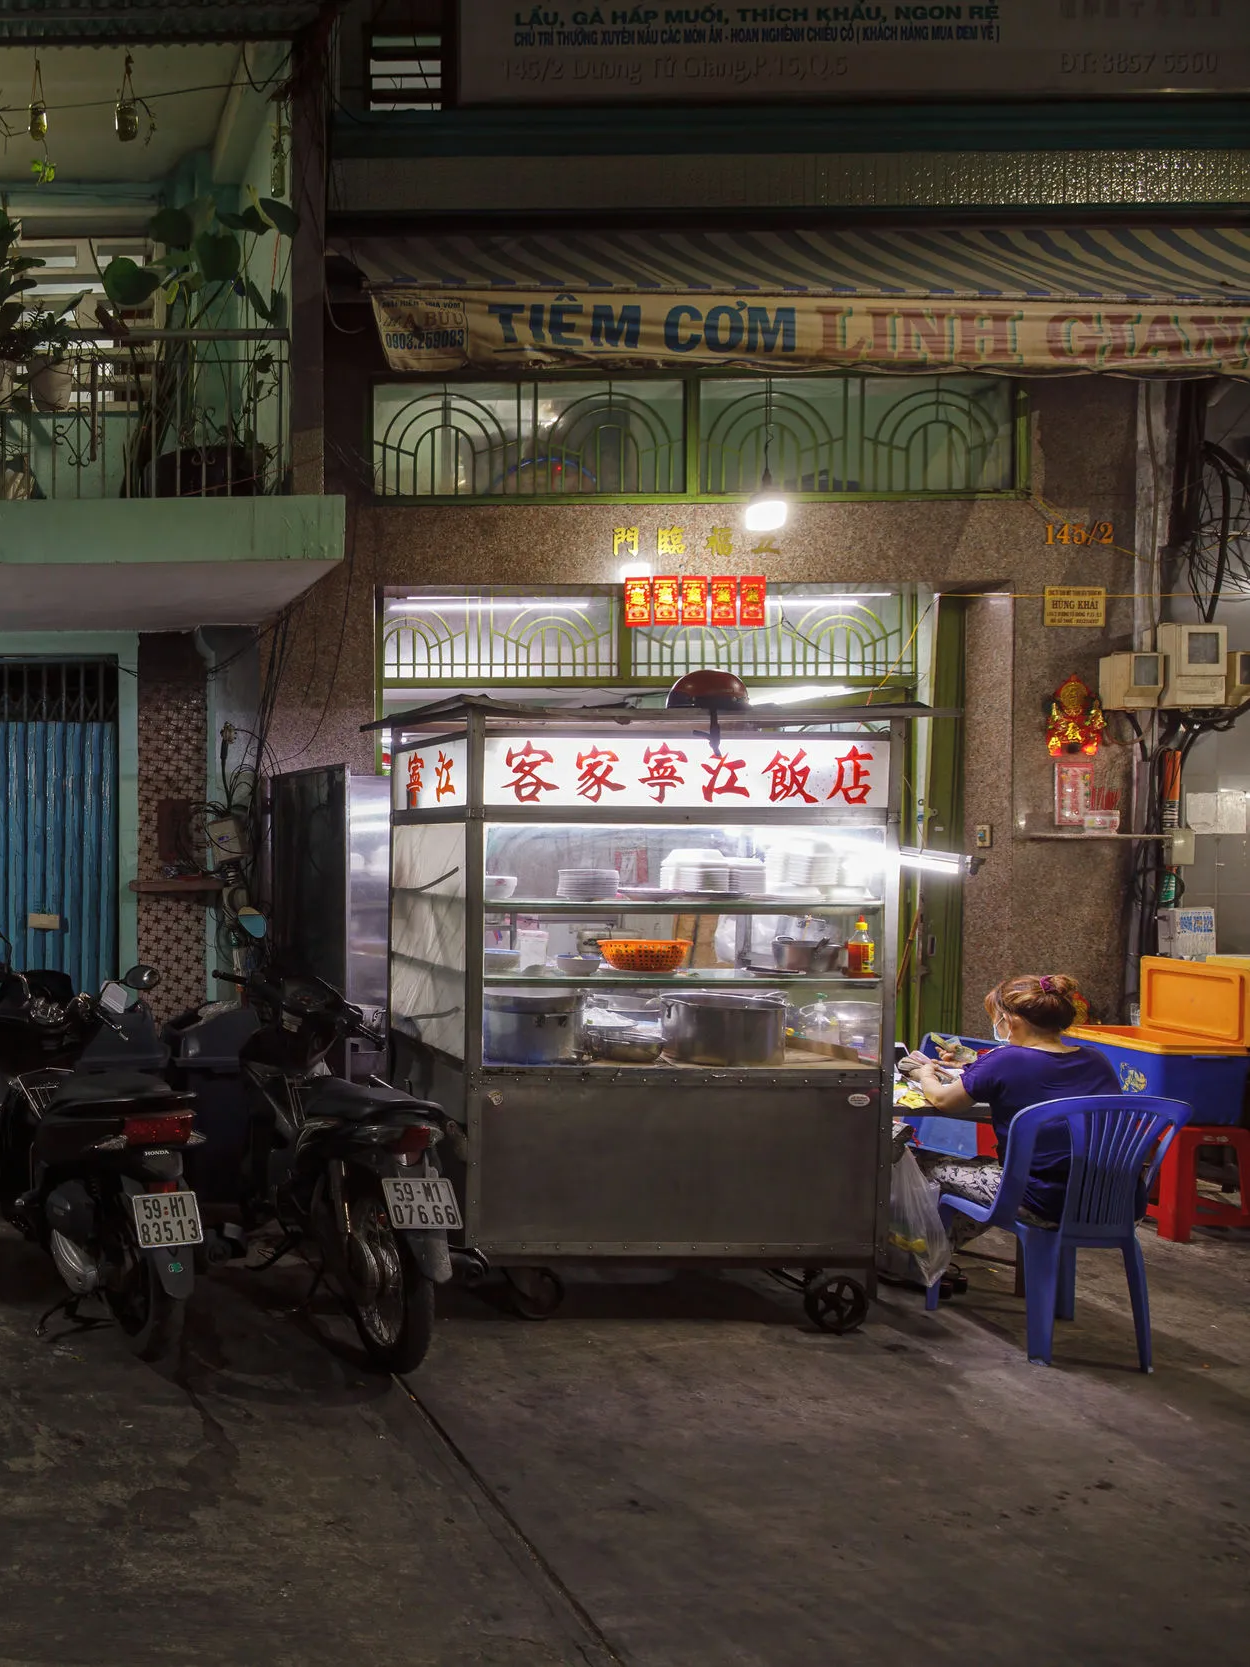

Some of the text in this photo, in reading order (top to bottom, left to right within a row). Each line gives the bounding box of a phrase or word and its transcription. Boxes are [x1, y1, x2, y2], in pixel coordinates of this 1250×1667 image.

[573, 6, 605, 25] GÀ
[612, 4, 658, 24] HẤP
[665, 2, 729, 26] MUỐI,
[737, 3, 809, 22] THÍCH
[895, 6, 962, 20] NGON
[931, 25, 954, 41] MUA
[664, 301, 797, 353] CƠM
[816, 306, 1023, 364] LINH
[1046, 309, 1250, 369] GIAN
[1045, 520, 1114, 545] 145/2
[405, 750, 456, 807] 寧江
[500, 739, 875, 806] 客家寧江飯店
[141, 1219, 199, 1243] 835.13
